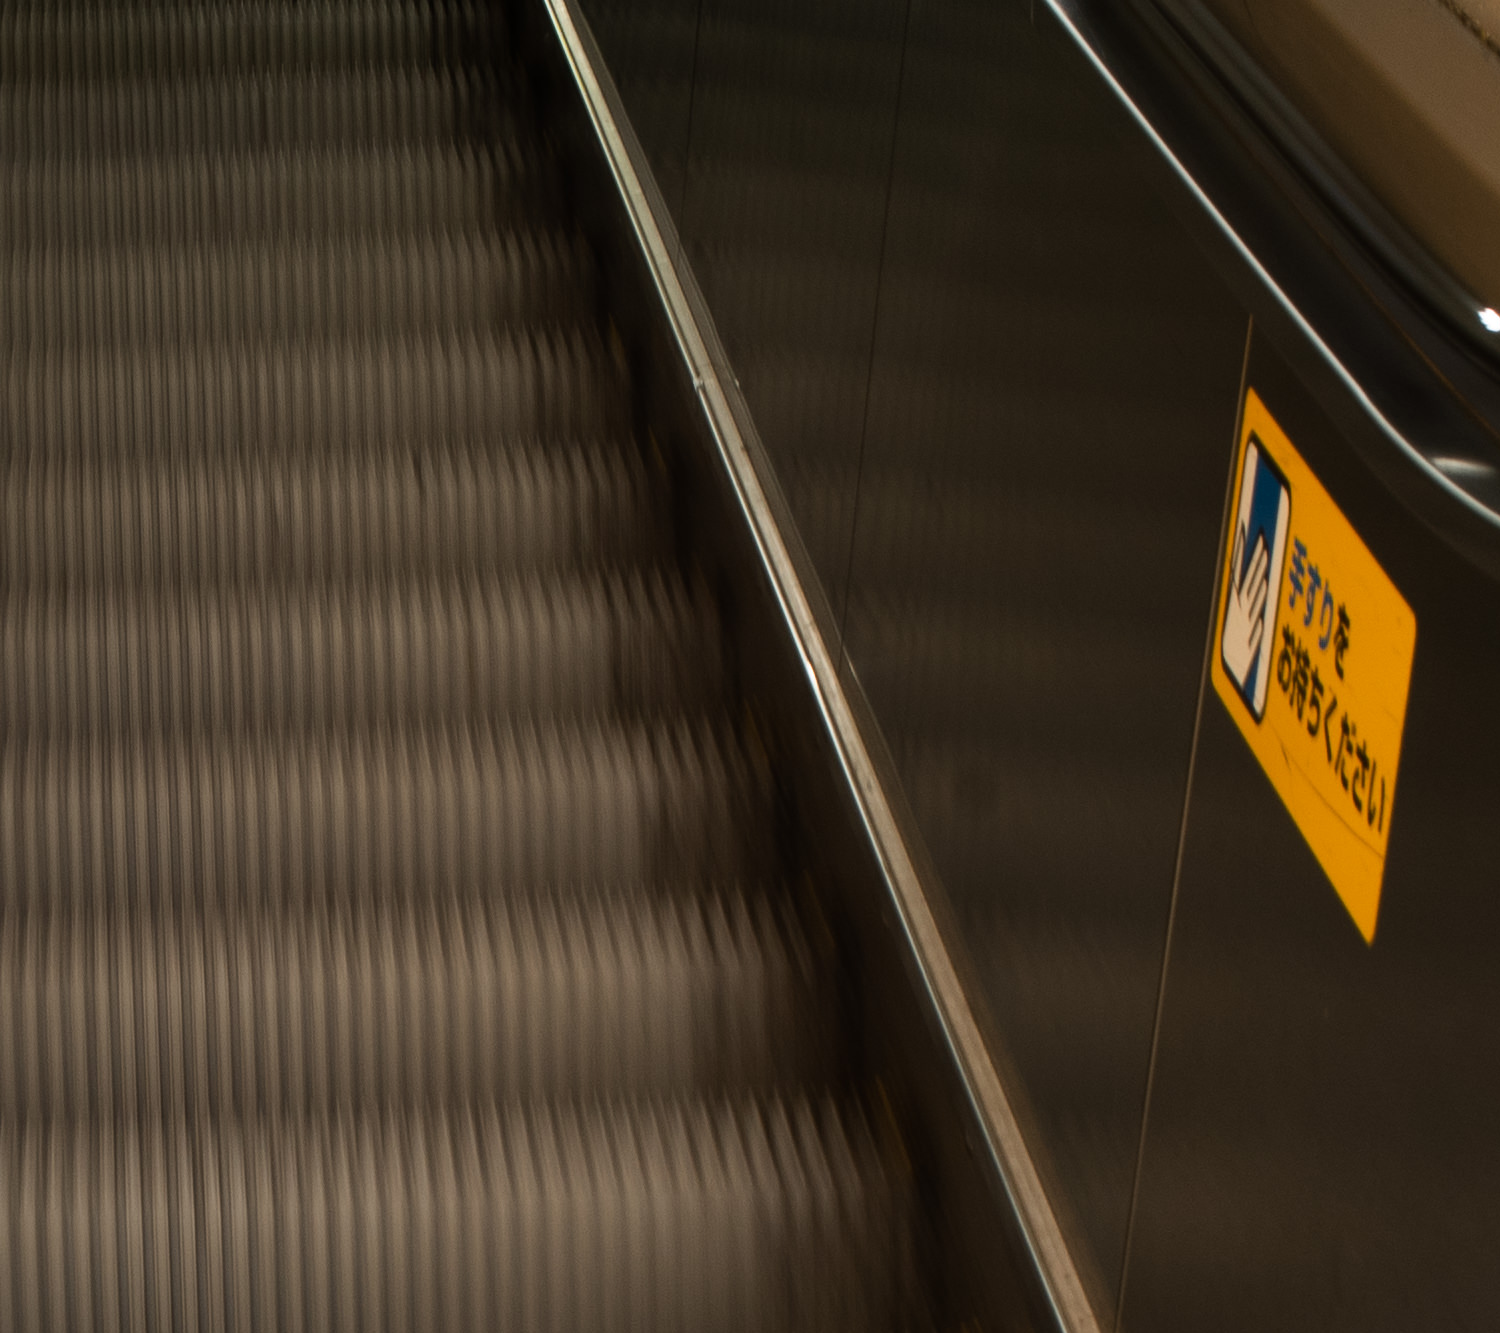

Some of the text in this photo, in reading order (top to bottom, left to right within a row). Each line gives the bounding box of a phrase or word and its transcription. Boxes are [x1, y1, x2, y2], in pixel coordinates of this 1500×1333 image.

[1289, 536, 1350, 681] 手すりを
[1277, 626, 1386, 834] お持ちください
